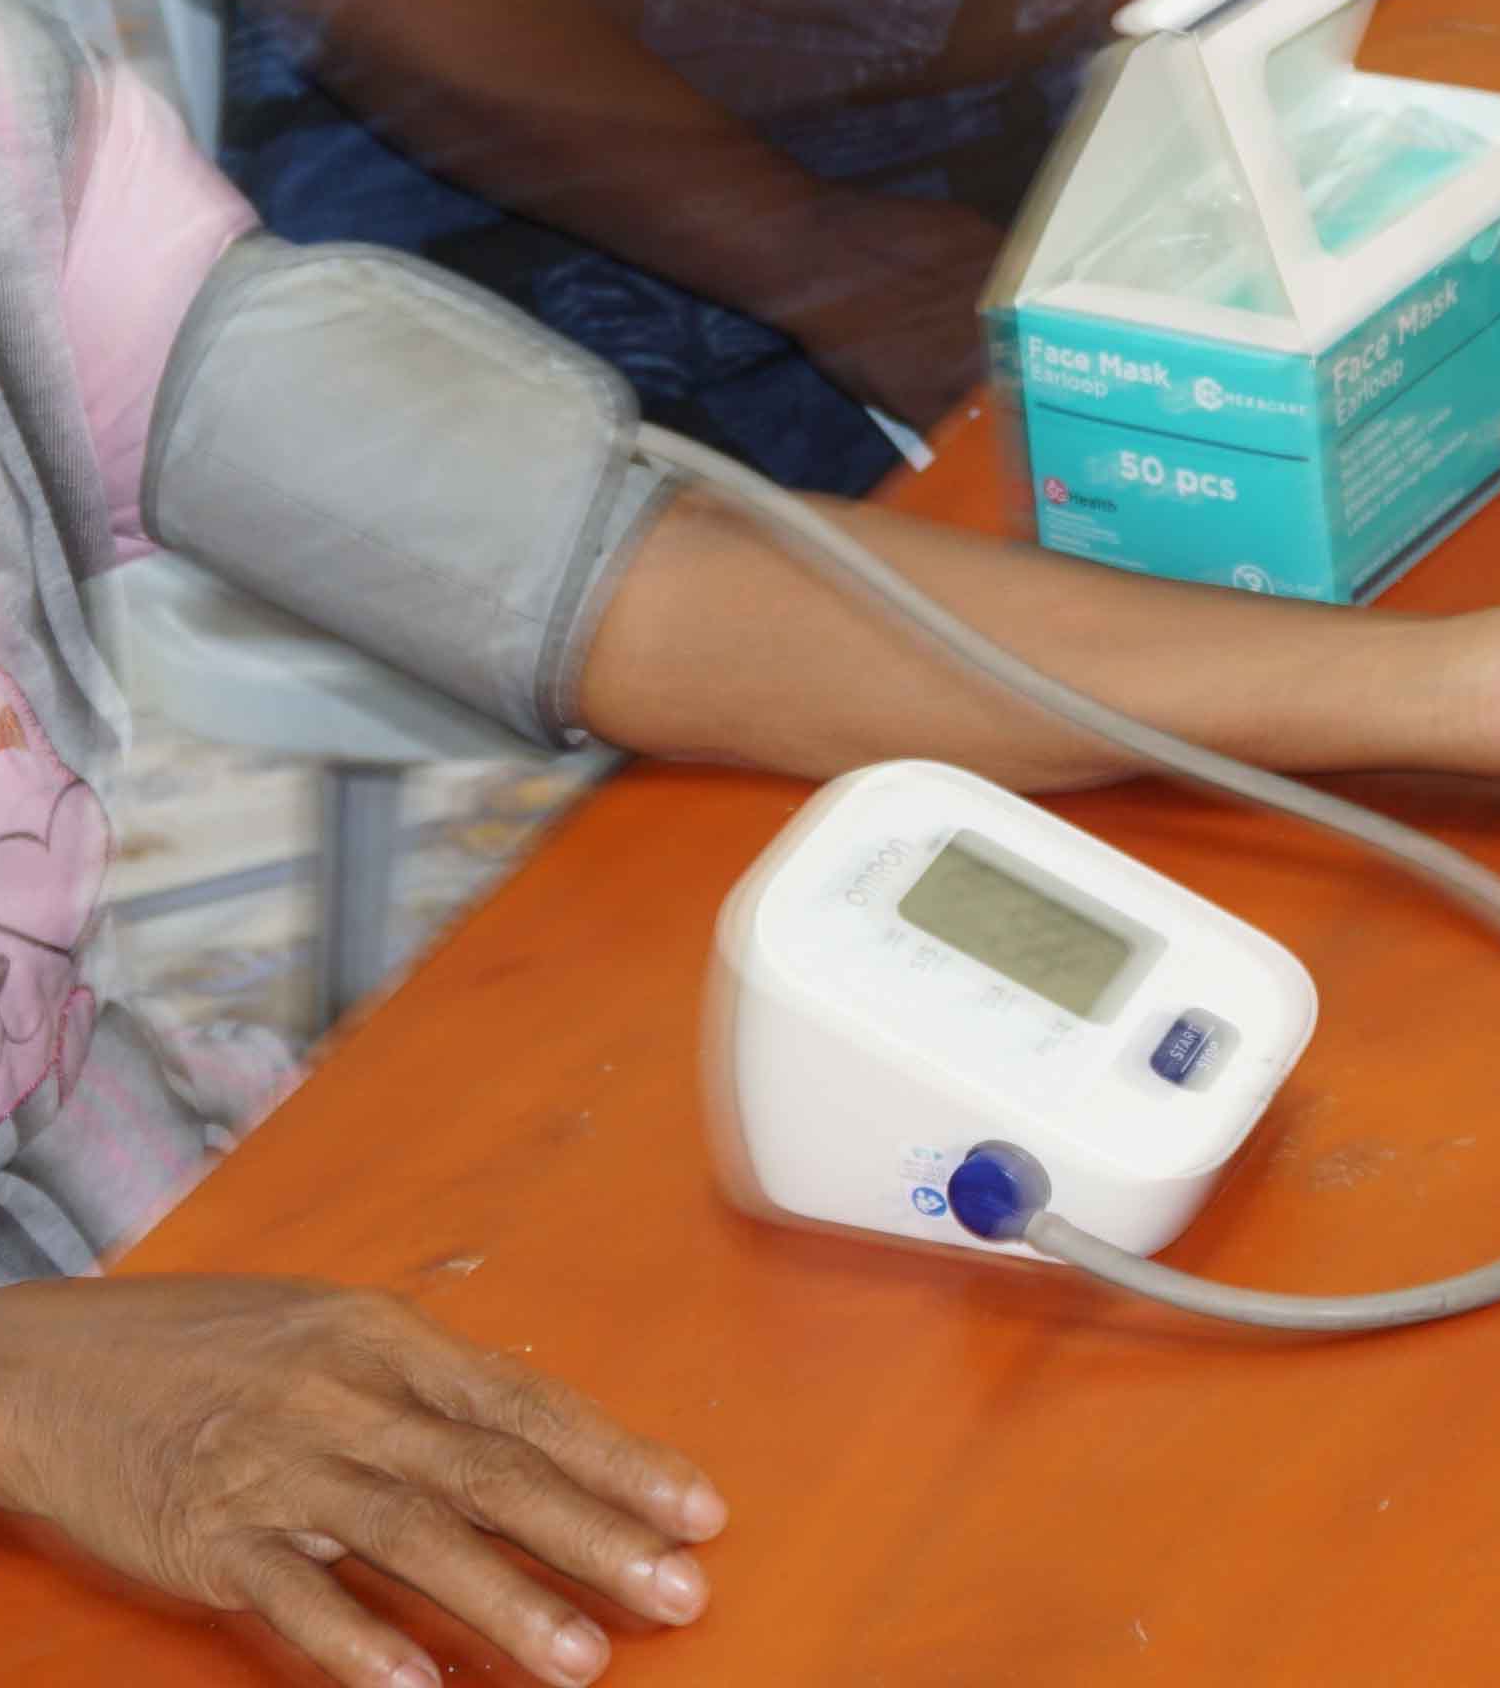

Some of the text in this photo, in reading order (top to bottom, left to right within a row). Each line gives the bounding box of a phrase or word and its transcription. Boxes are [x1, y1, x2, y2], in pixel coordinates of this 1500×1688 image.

[1027, 335, 1172, 389] Face Mask
[1332, 277, 1460, 397] Face Mask
[1030, 364, 1109, 399] Earloop
[1336, 360, 1405, 426] Earloop
[1119, 450, 1238, 501] 50 pcs
[1170, 1023, 1202, 1063] START
